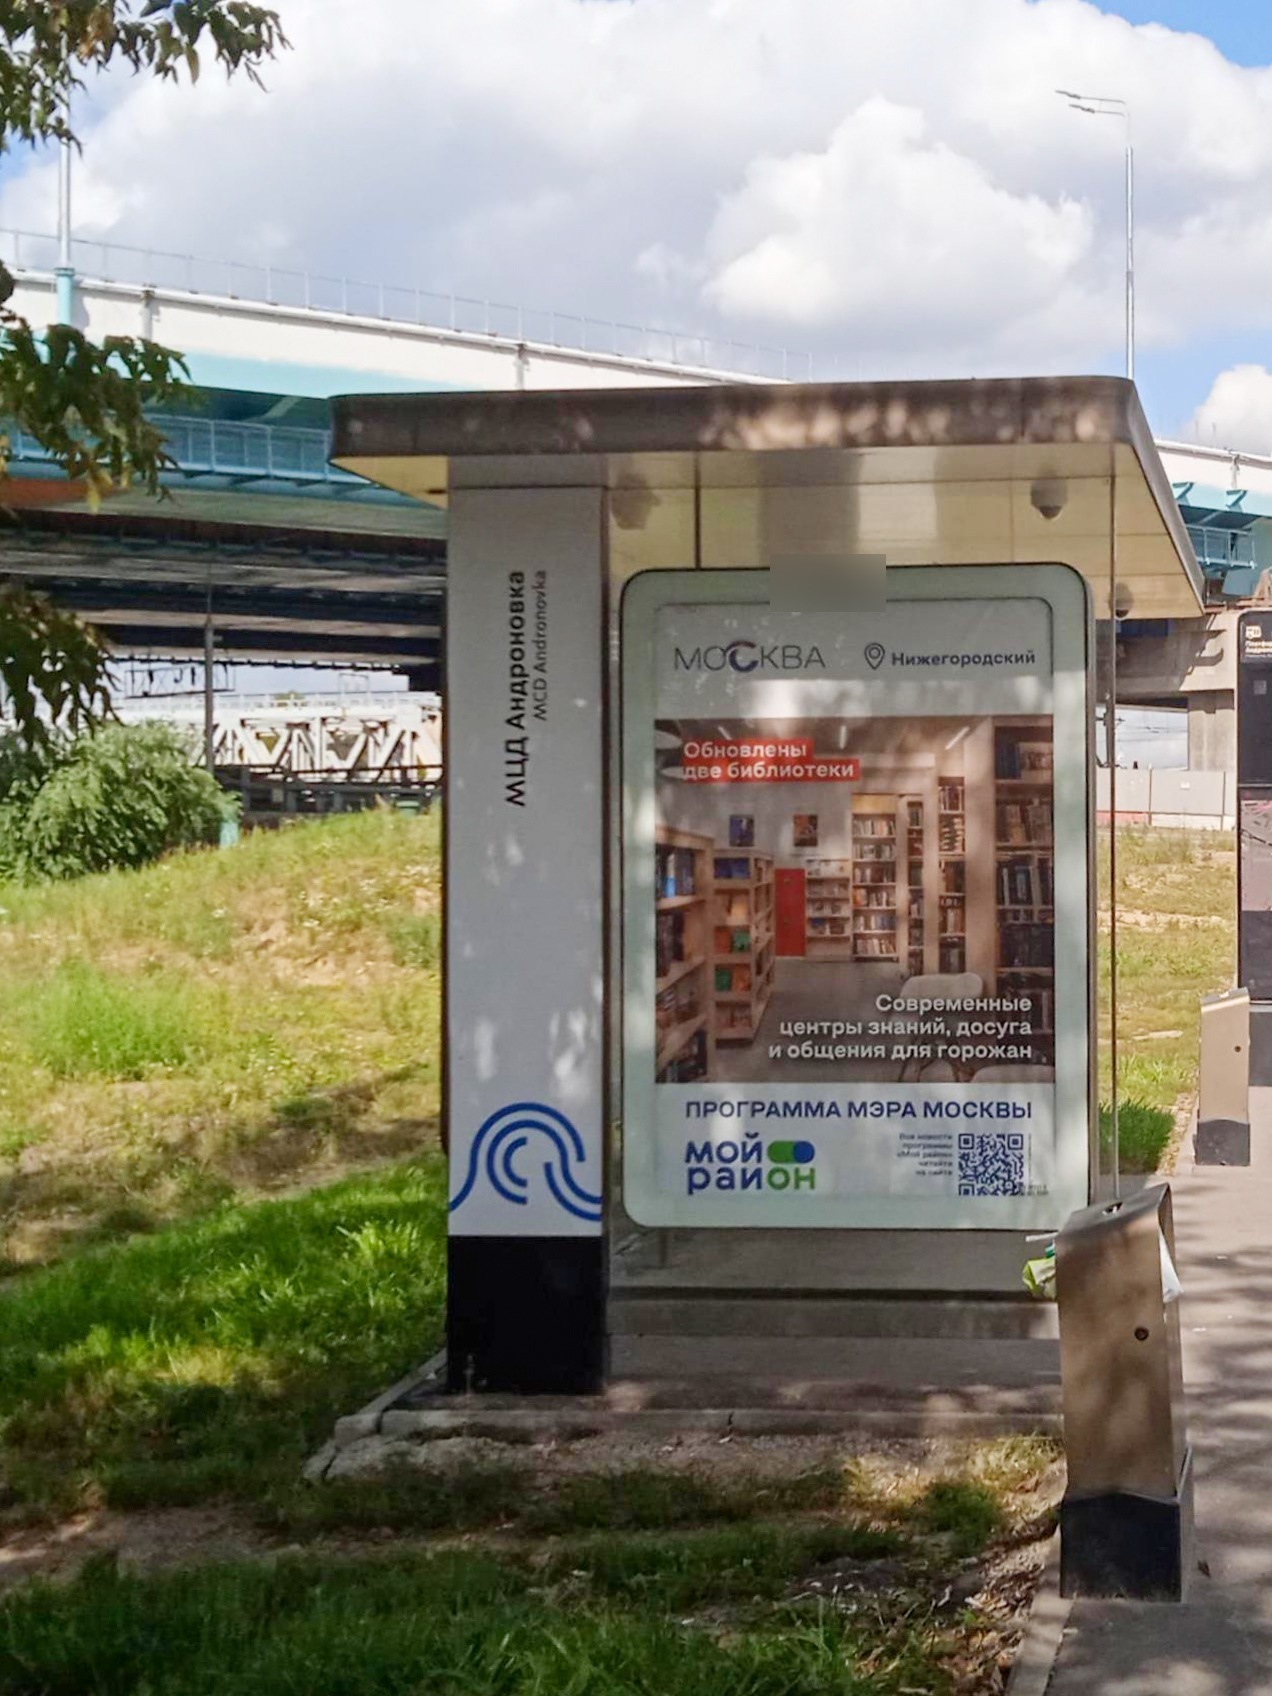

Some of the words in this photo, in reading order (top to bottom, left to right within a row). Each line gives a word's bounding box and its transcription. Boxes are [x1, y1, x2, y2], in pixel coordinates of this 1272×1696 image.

[531, 570, 548, 673] Andronovka
[505, 571, 530, 730] Андроновка
[674, 641, 826, 672] МОСКВА
[891, 649, 1036, 668] Нижегородский
[532, 678, 548, 721] MCD
[683, 741, 807, 759] Обновлены
[504, 737, 530, 807] МЦД
[684, 765, 722, 780] две
[727, 760, 855, 779] библиотеки
[875, 994, 1032, 1015] Современные
[779, 1021, 862, 1037] центры
[868, 1017, 951, 1037] знаний,
[956, 1021, 1032, 1038] досуга
[768, 1045, 781, 1058] и
[787, 1041, 886, 1061] общения
[891, 1044, 934, 1060] для
[938, 1045, 1032, 1061] горожан
[685, 1101, 841, 1119] ПРОГРАММА
[847, 1101, 917, 1119] МЭРА
[923, 1101, 1032, 1119] МОСКВЫ
